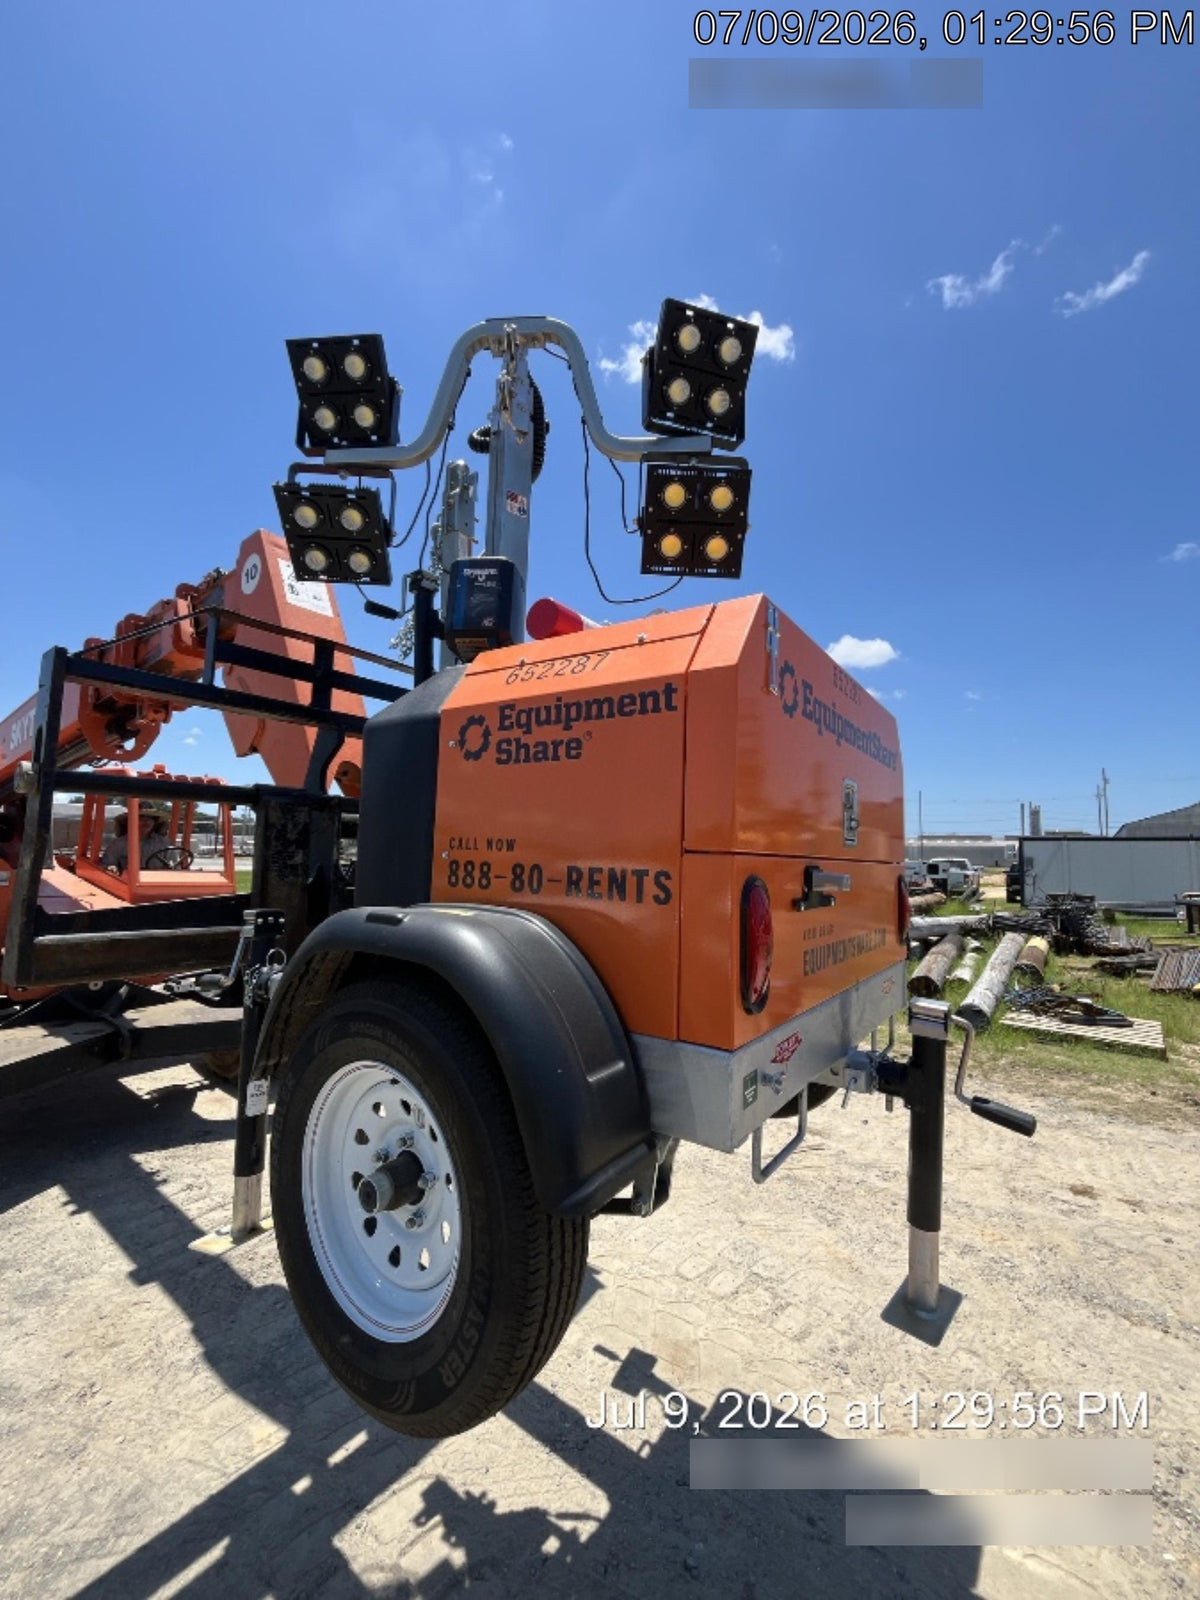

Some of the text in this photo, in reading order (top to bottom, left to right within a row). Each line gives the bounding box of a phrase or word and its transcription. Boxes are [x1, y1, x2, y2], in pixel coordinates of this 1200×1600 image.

[244, 562, 259, 584] 10
[505, 651, 612, 685] 652287
[497, 682, 679, 735] Equipment
[801, 679, 897, 772] EquipmentShare
[495, 736, 583, 766] Share
[449, 837, 517, 852] CALL NOW
[447, 859, 673, 906] 888-80-RENTS
